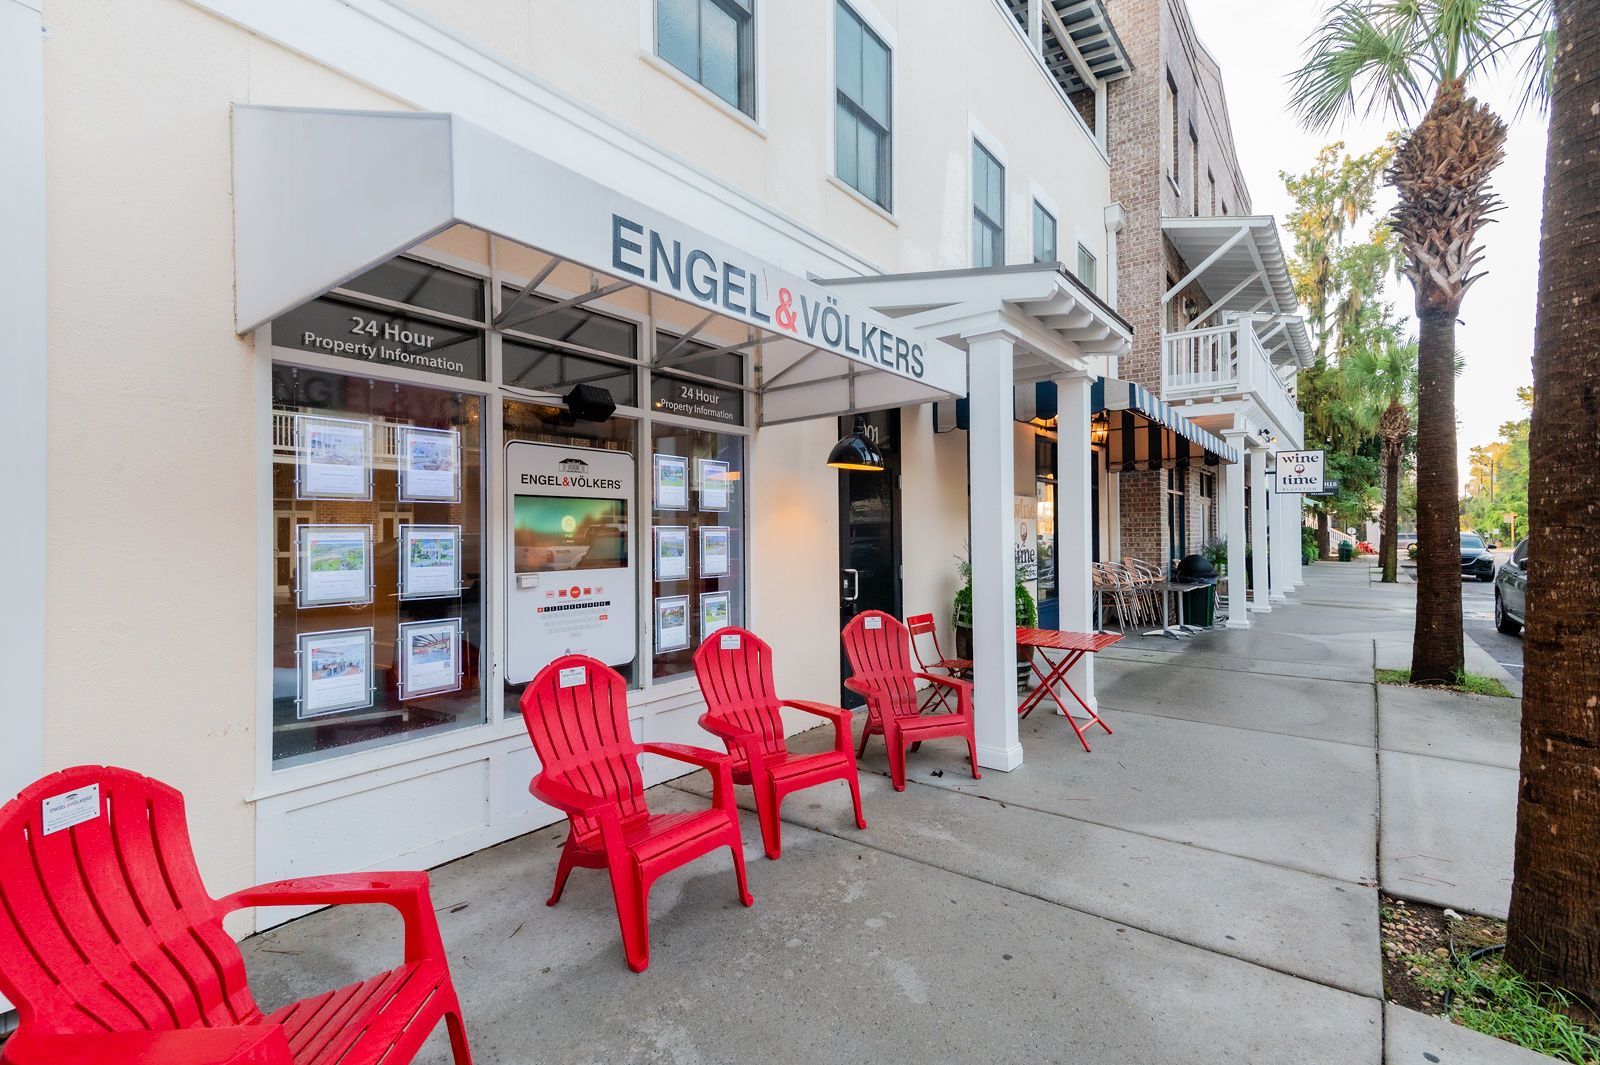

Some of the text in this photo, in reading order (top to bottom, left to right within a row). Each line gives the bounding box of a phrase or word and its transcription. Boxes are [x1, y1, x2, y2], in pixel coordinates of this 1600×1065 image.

[351, 316, 435, 348] 24 Hour
[304, 331, 464, 373] Property Information
[681, 386, 720, 405] 24 Hour
[660, 398, 733, 420] Property Information
[1282, 453, 1319, 463] wine
[1282, 475, 1318, 485] time
